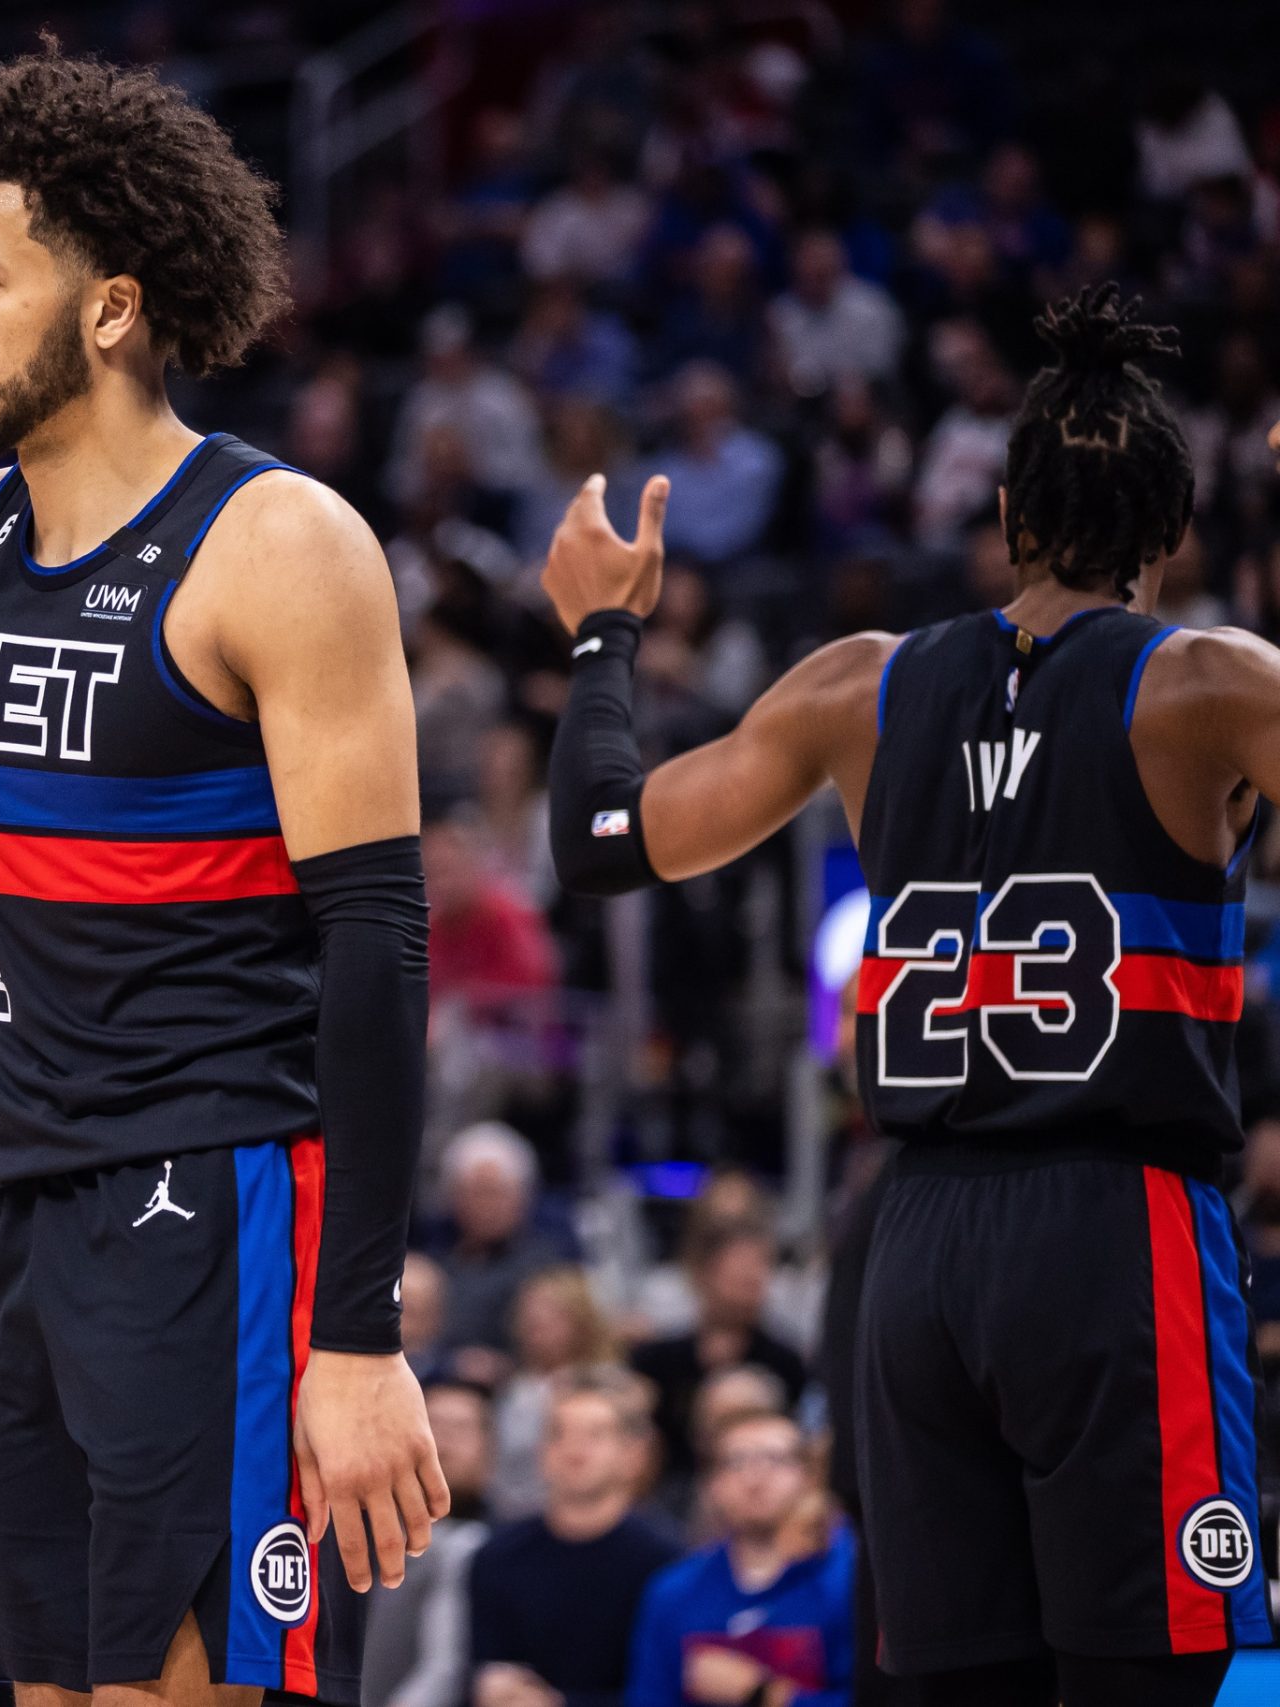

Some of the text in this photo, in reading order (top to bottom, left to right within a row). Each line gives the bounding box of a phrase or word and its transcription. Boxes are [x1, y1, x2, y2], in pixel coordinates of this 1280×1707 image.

[136, 543, 162, 564] 16
[85, 584, 142, 612] UWM
[962, 727, 1042, 813] IVY
[877, 872, 1122, 1087] 23
[1197, 1528, 1243, 1559] DET
[265, 1554, 304, 1590] DET
